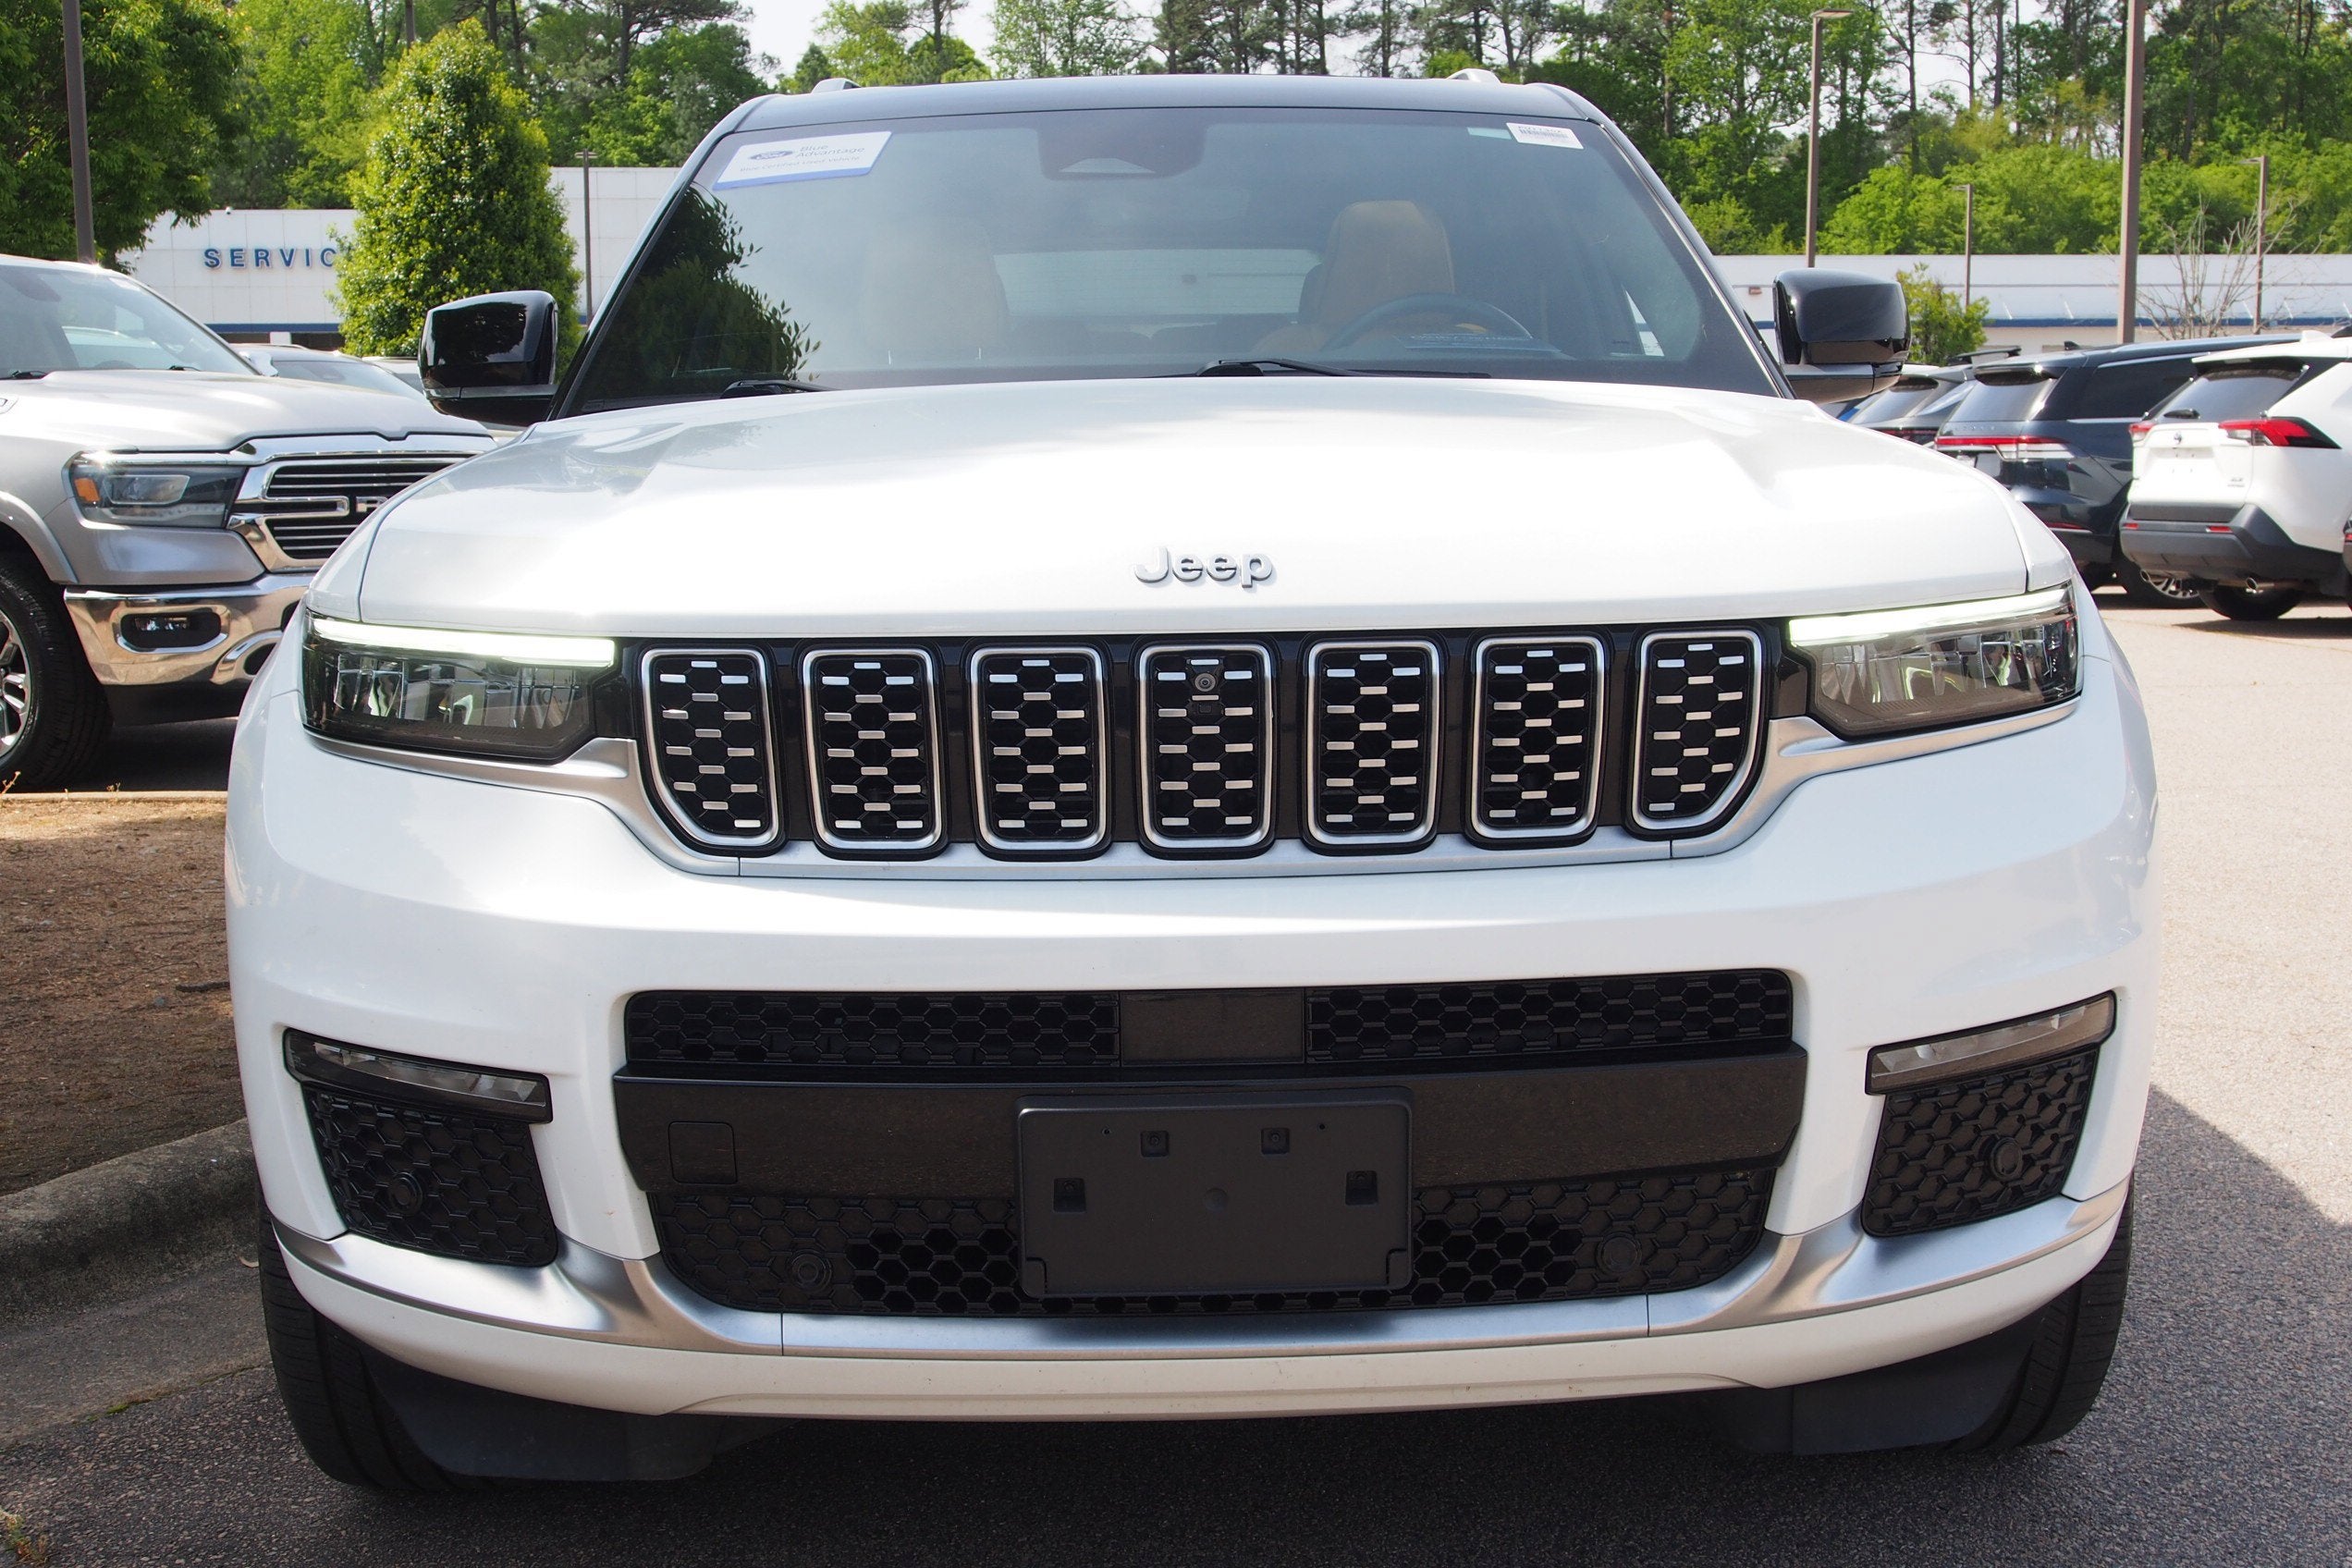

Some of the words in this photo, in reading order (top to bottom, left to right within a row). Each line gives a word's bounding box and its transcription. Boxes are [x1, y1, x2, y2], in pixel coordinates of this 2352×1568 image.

[795, 147, 865, 158] Advantage
[203, 248, 337, 268] SERVIC
[1133, 546, 1272, 589] Jeep
